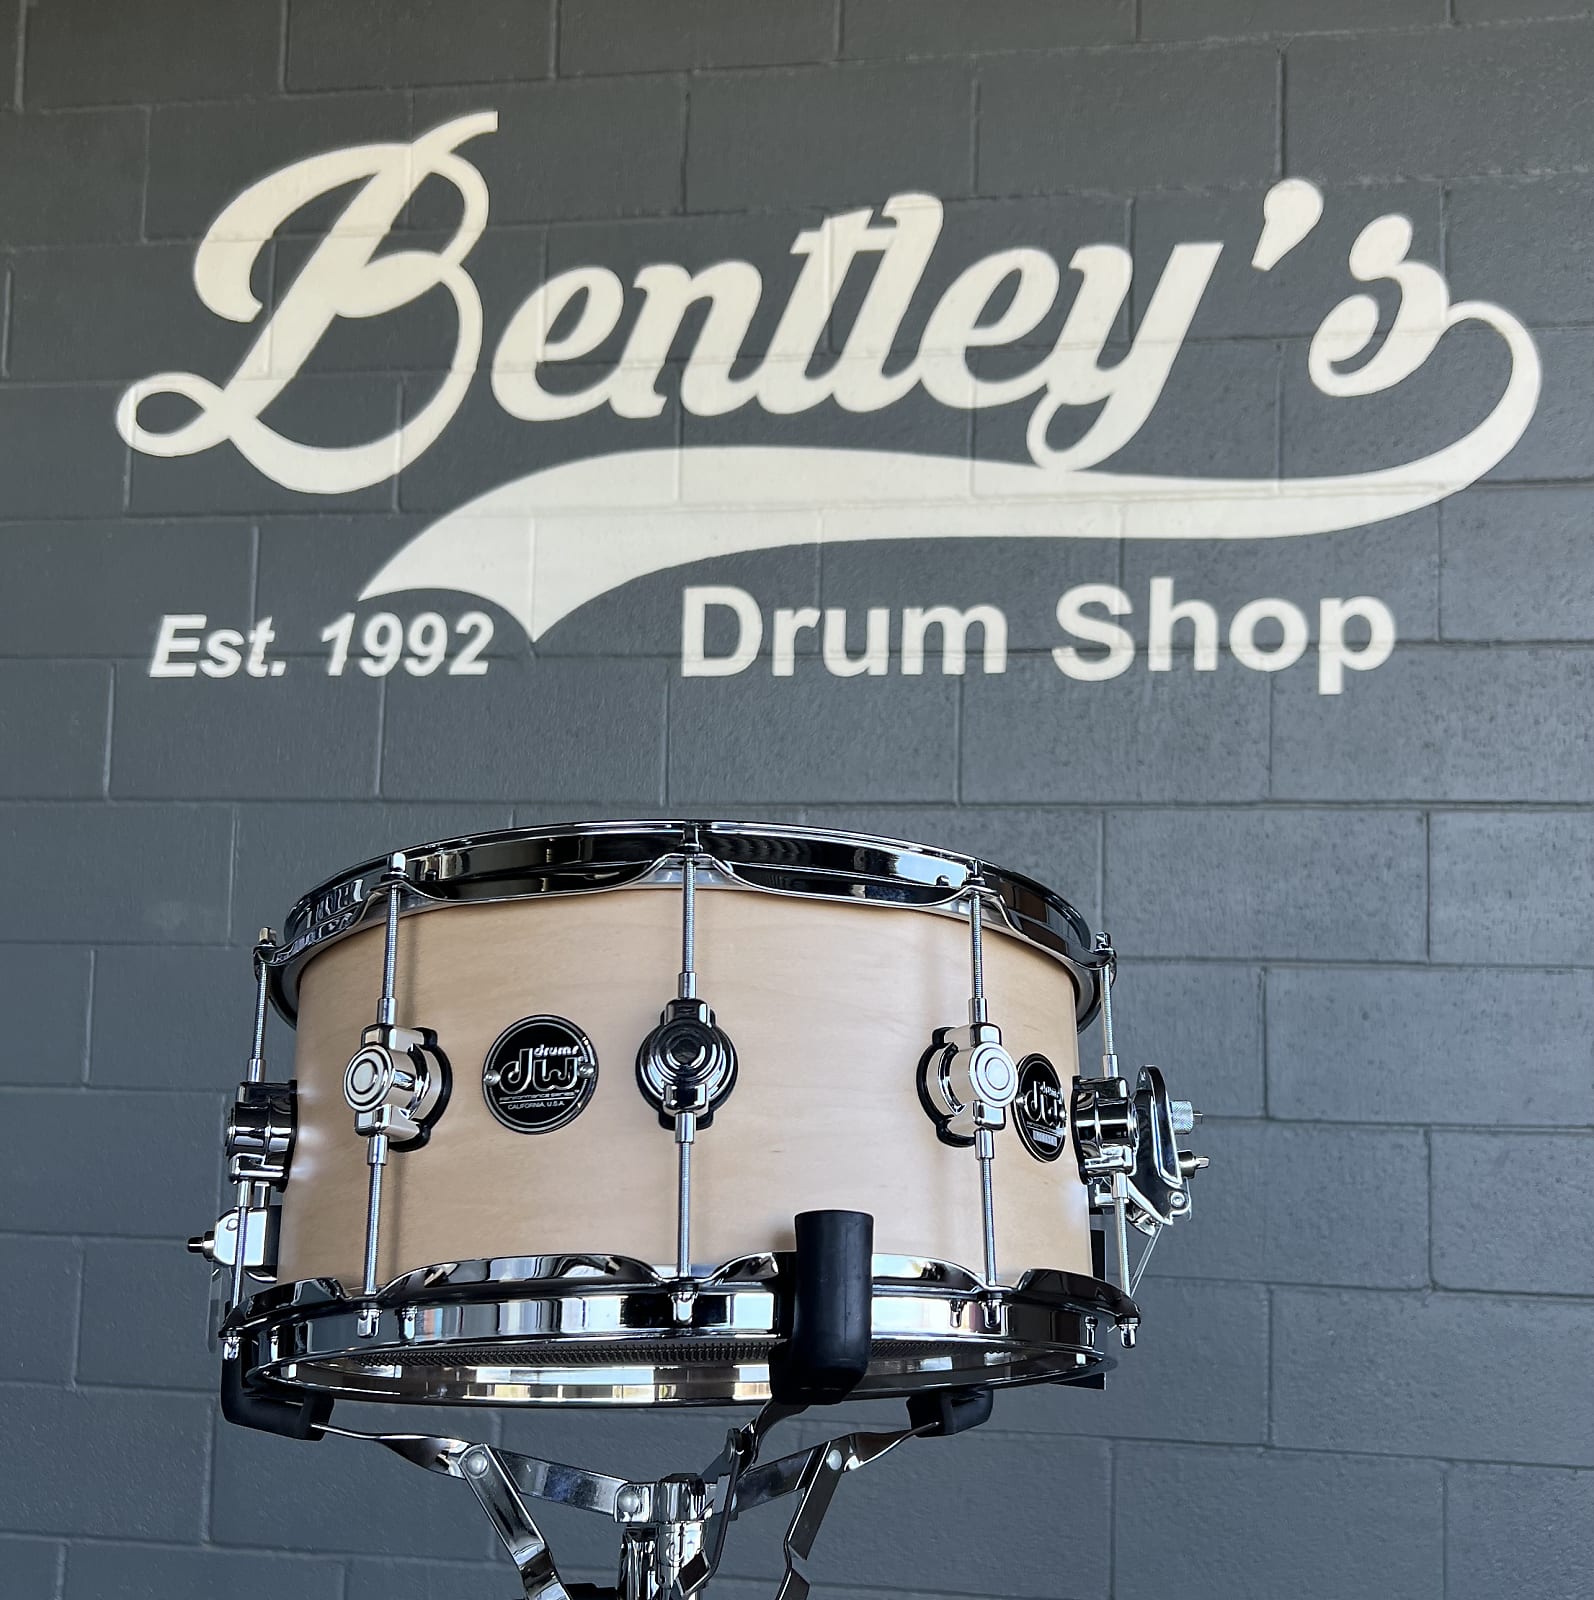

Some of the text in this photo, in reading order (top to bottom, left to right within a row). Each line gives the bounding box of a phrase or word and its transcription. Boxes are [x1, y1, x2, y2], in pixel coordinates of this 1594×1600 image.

[116, 111, 1490, 494] Bentley's
[149, 611, 495, 679] Est. 1992
[681, 575, 1398, 696] Drum Shop
